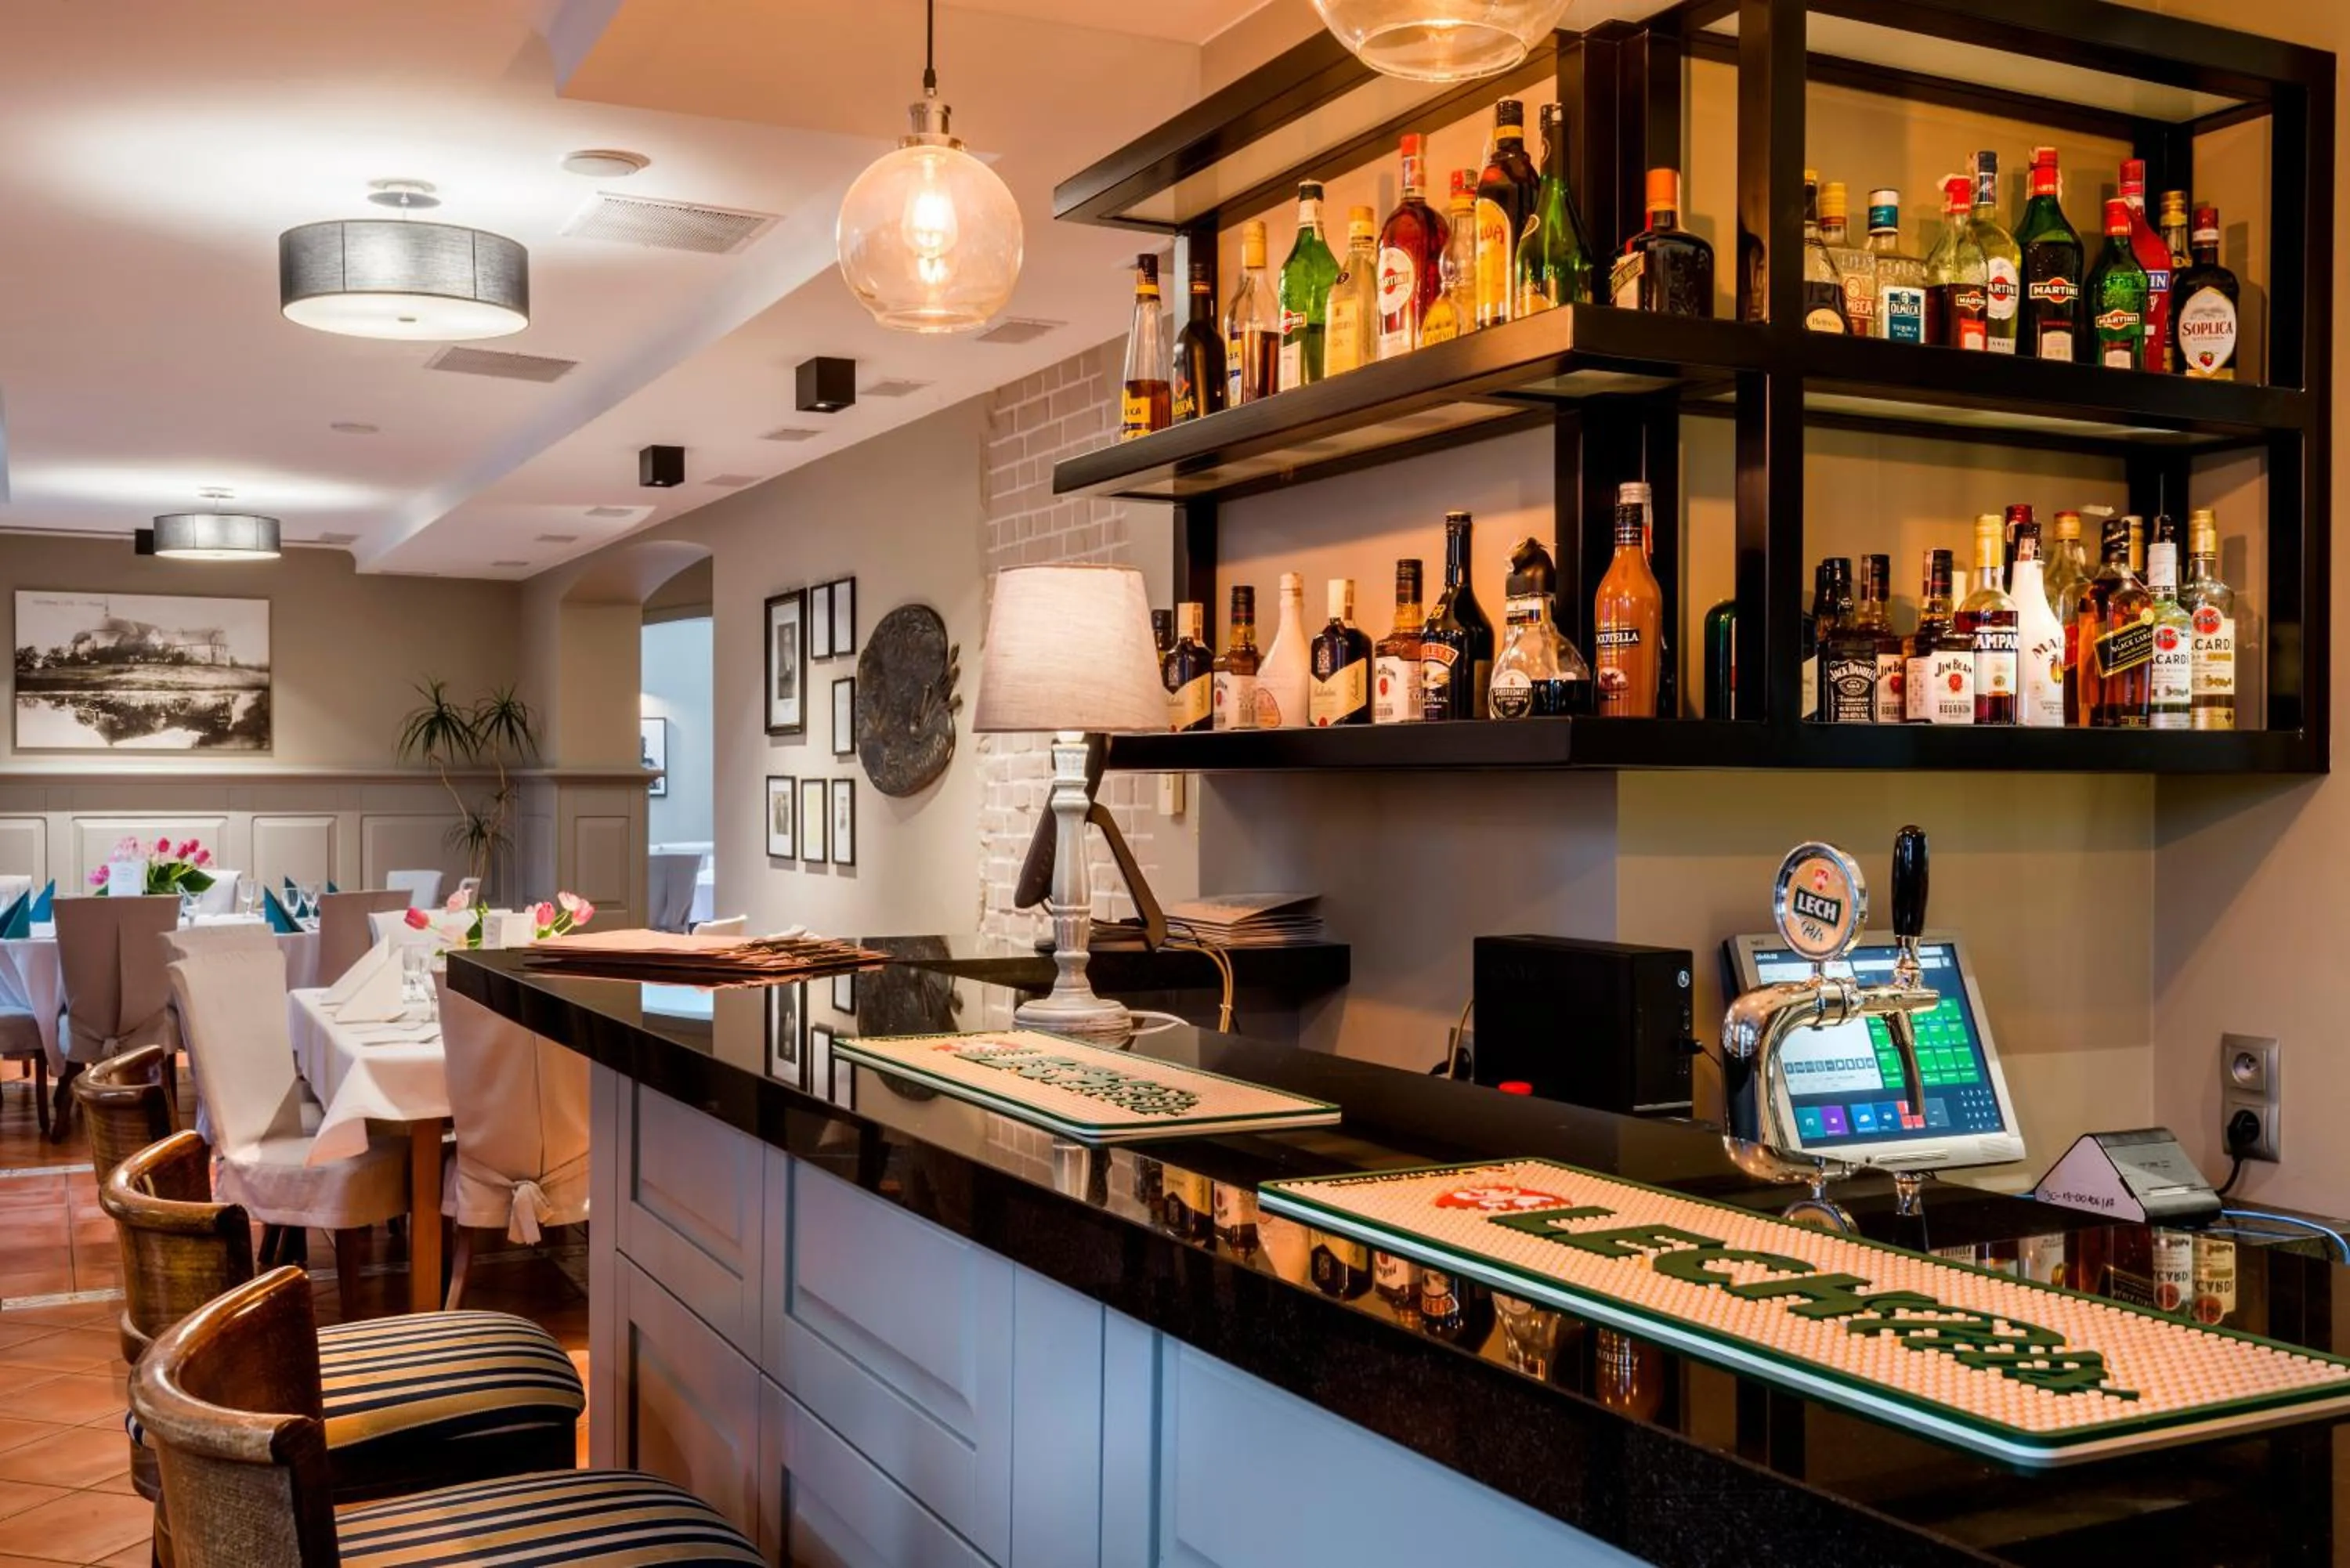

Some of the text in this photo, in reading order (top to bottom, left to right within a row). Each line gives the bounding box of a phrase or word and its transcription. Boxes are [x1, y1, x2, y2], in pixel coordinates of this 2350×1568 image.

[2034, 286, 2078, 296] MARTINI
[1890, 303, 1918, 314] OLMECA
[2098, 315, 2136, 326] MARTINI
[2182, 320, 2233, 337] SOPLICA
[1829, 666, 1848, 682] JACK
[1934, 662, 1951, 677] JIM
[1796, 892, 1838, 922] LECH
[1488, 1206, 1938, 1321] LECH
